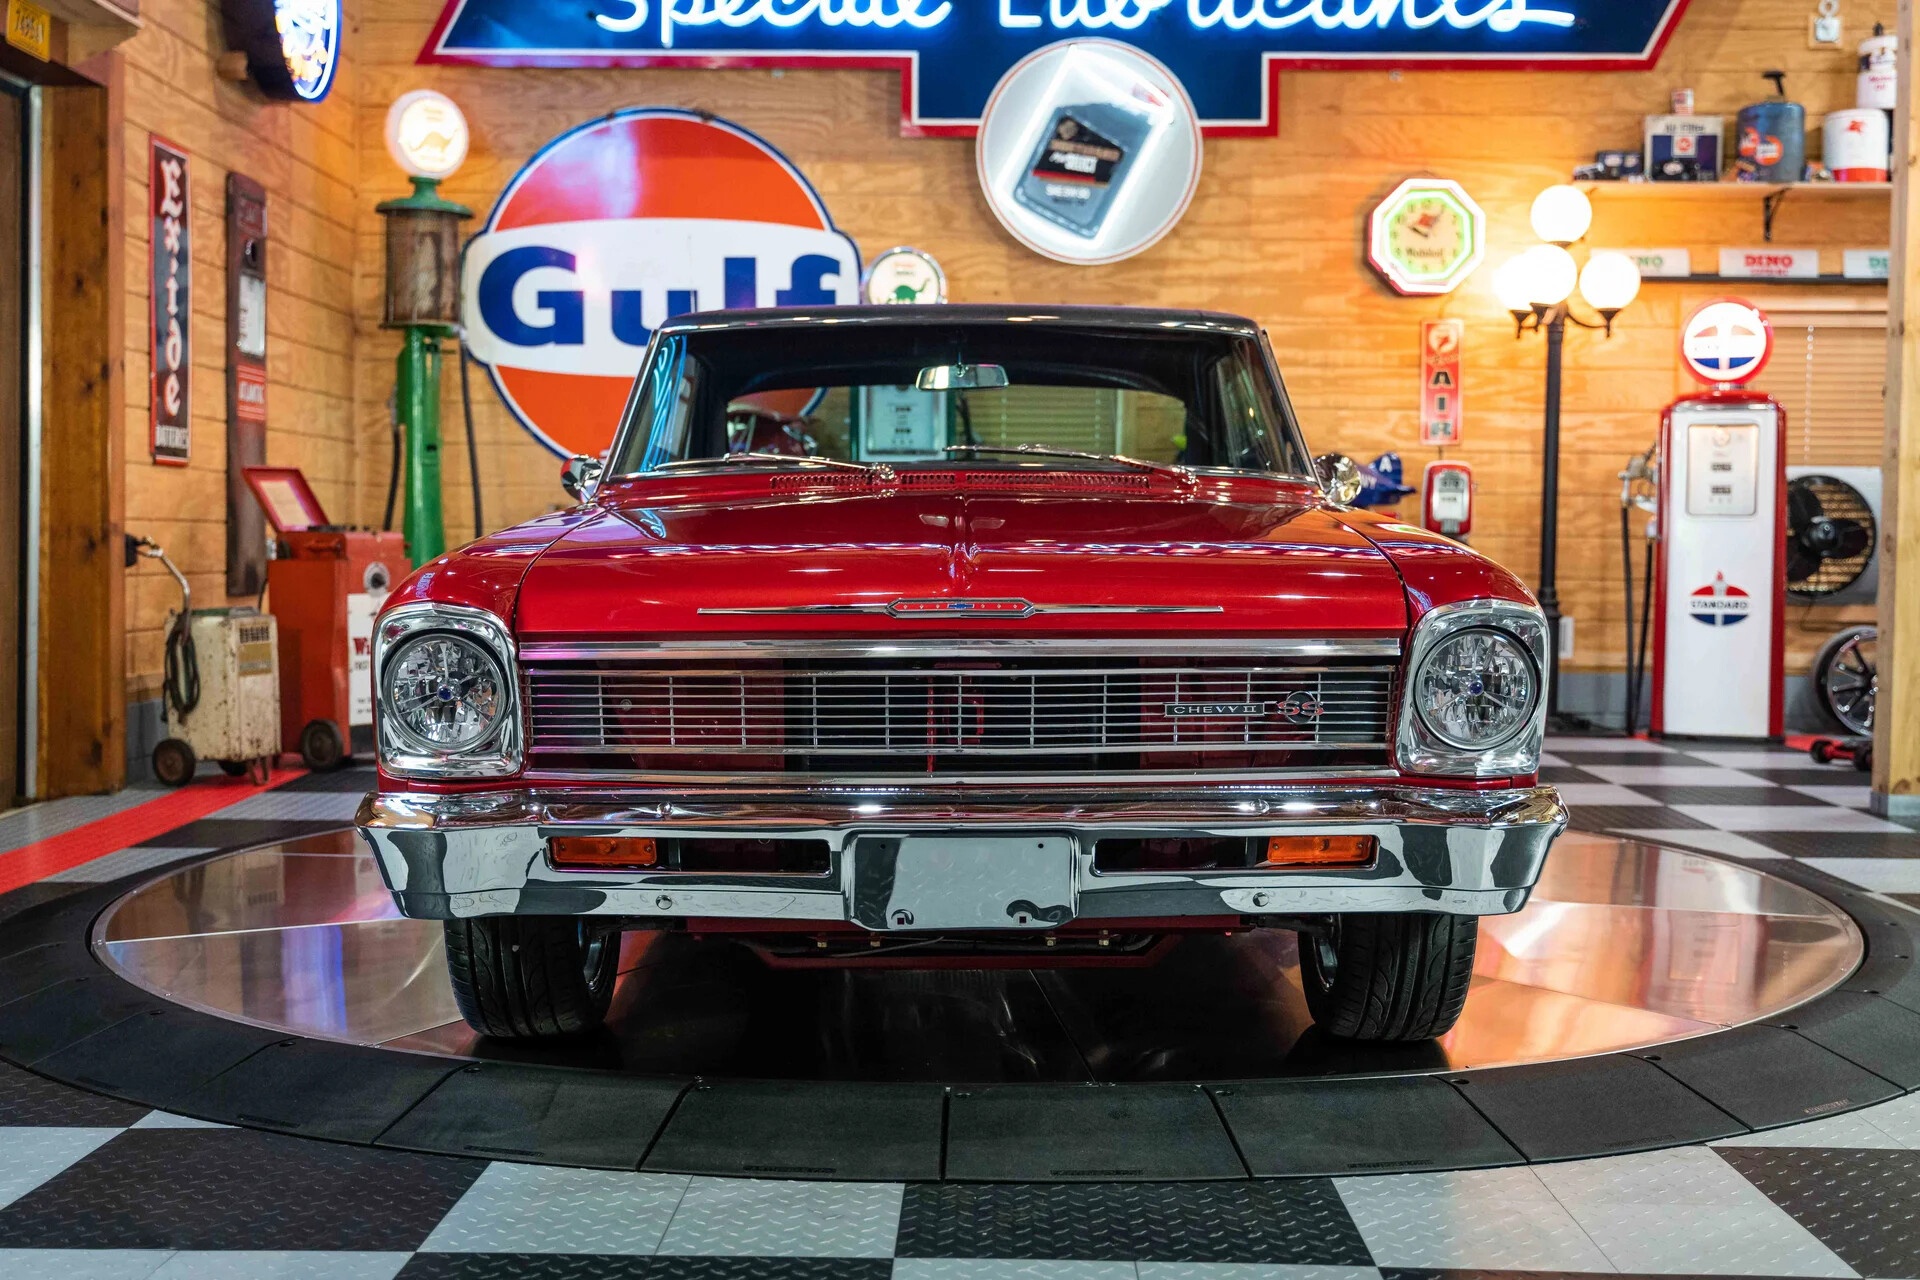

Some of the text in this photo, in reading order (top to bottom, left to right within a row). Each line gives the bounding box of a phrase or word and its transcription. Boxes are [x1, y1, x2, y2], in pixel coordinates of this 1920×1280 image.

[1744, 255, 1793, 267] DINO
[160, 157, 183, 418] Exide
[478, 245, 841, 347] Gulf
[1430, 369, 1453, 437] AIR
[1379, 455, 1393, 472] A
[1690, 600, 1749, 610] STANDARD
[1173, 705, 1257, 714] CHEVY II
[1277, 701, 1324, 716] SS
